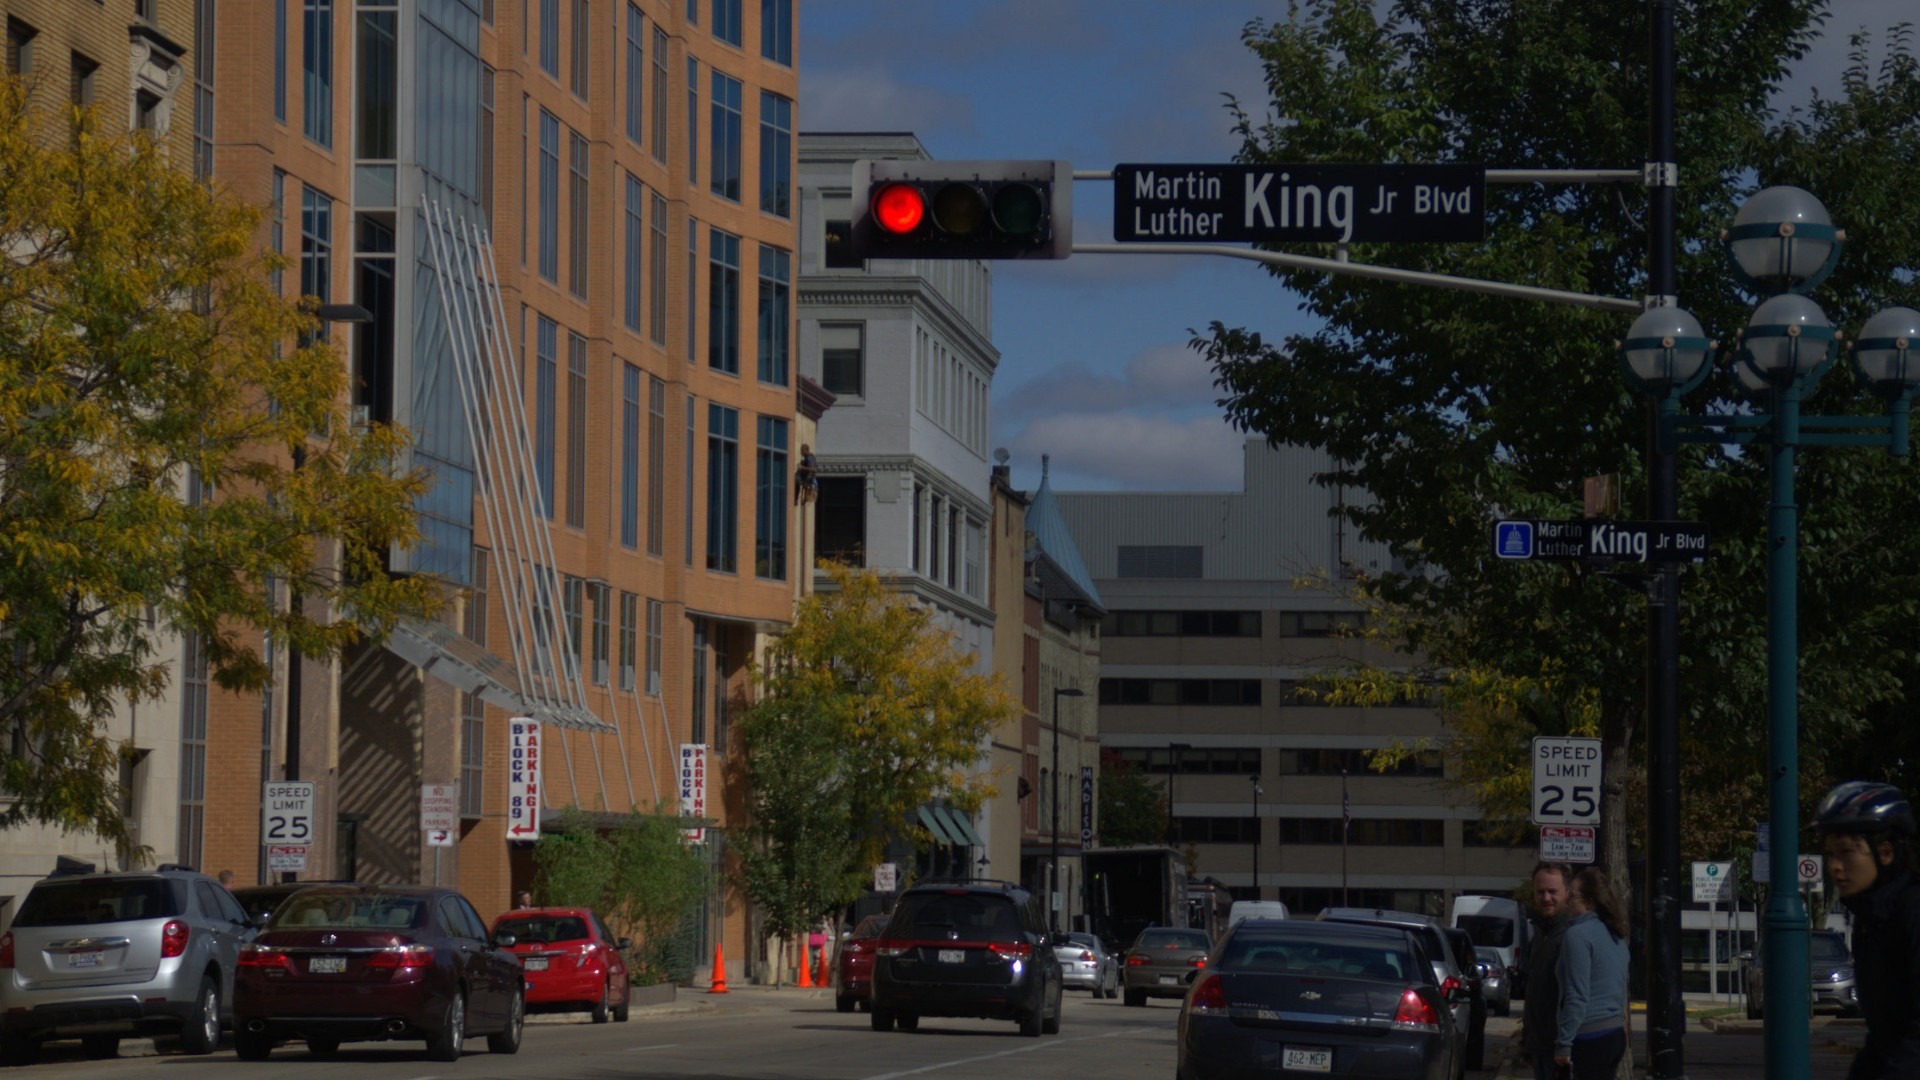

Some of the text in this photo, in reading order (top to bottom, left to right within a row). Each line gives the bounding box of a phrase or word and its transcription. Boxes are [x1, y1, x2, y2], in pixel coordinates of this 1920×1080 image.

[1134, 170, 1222, 200] Martin
[1134, 205, 1223, 236] Luther
[1244, 172, 1472, 244] King Jr Blvd
[1537, 521, 1583, 538] Martin
[1590, 523, 1706, 563] King Jr Blvd
[1537, 540, 1585, 557] Luther
[526, 723, 538, 807] PARKING
[1540, 745, 1598, 760] SPEED
[511, 723, 523, 819] BLOCK 89
[682, 748, 692, 798] BLOCK
[693, 748, 704, 818] PARKING
[1546, 763, 1591, 778] LIMIT
[268, 787, 311, 798] SPEED
[272, 800, 306, 811] LIMIT
[432, 787, 445, 796] NO
[1539, 785, 1596, 818] 25
[268, 816, 309, 839] 25
